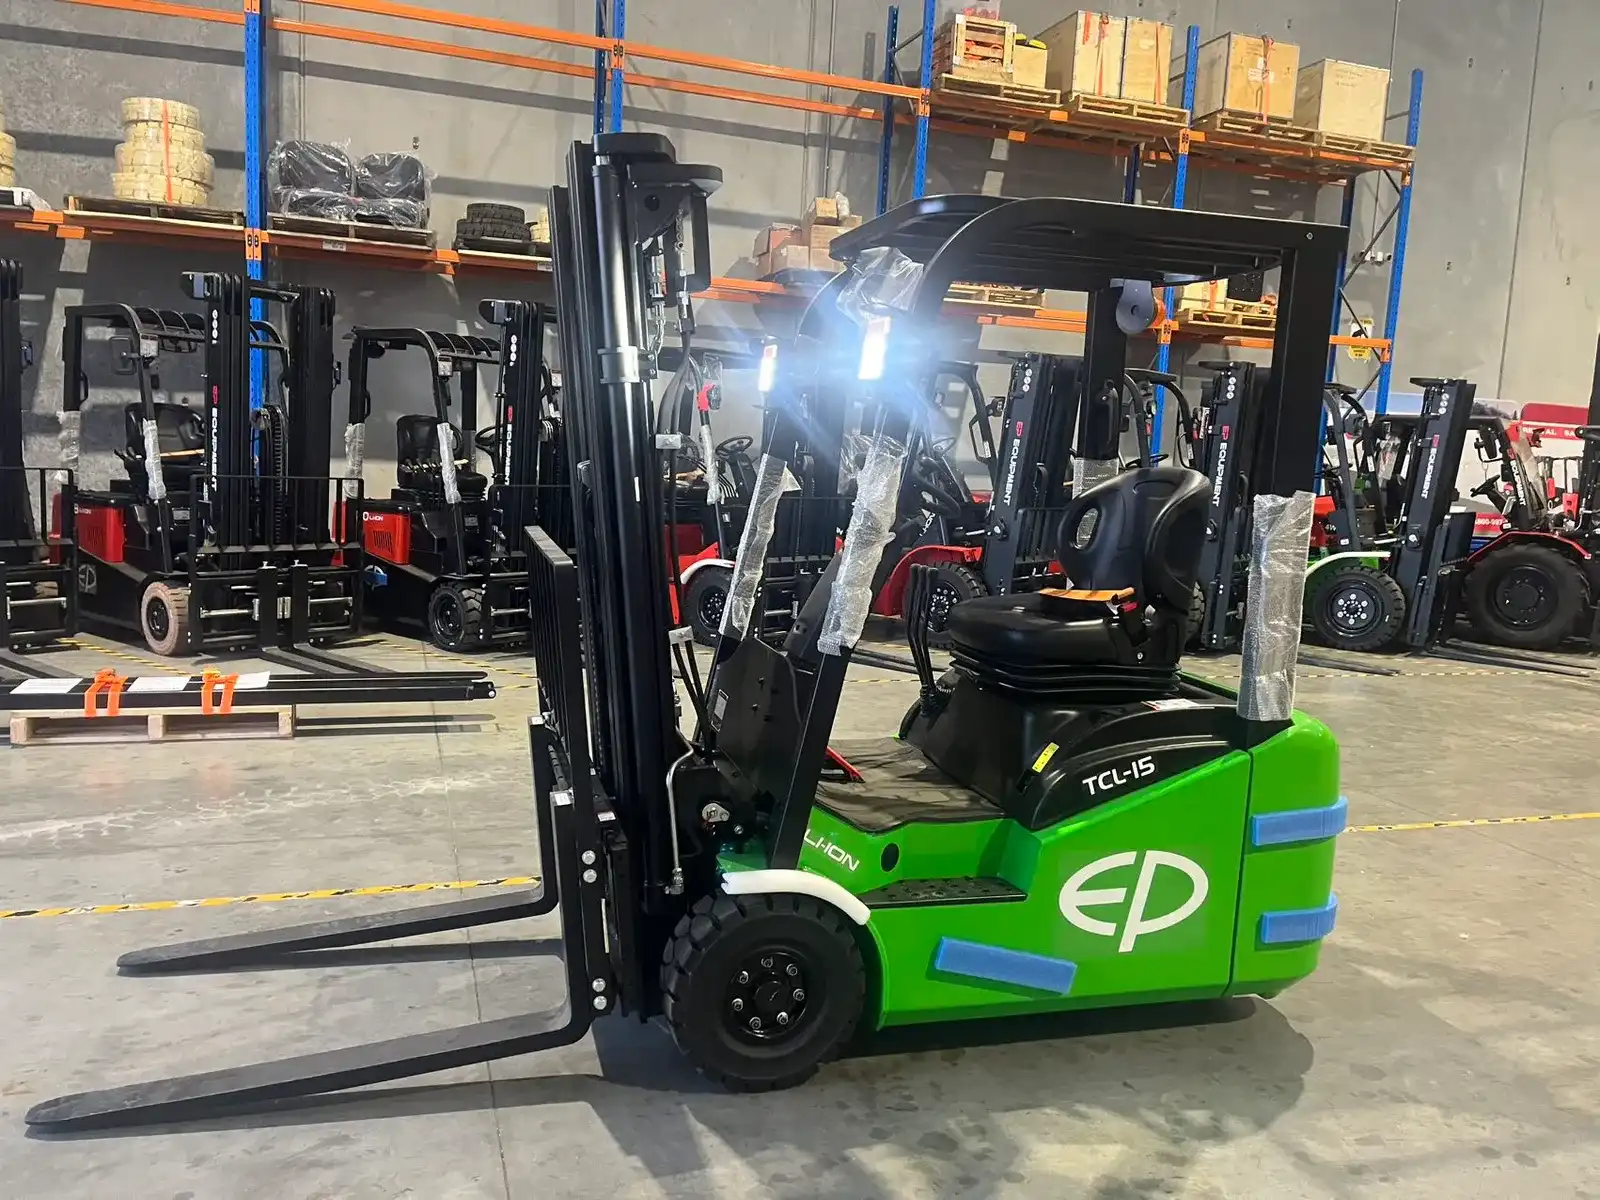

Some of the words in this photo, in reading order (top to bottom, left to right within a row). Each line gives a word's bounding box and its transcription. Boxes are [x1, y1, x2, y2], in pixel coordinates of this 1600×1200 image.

[1015, 421, 1024, 437] EP
[1221, 425, 1231, 441] EP
[1003, 438, 1021, 506] EQUIPMENT
[1212, 442, 1228, 507] EQUIPMENT
[1421, 448, 1437, 499] EQUIPMENT
[1510, 460, 1526, 506] EQUIPMENT
[1082, 756, 1156, 796] TCL-15
[803, 828, 860, 872] LI-ION
[1059, 850, 1209, 953] EP
